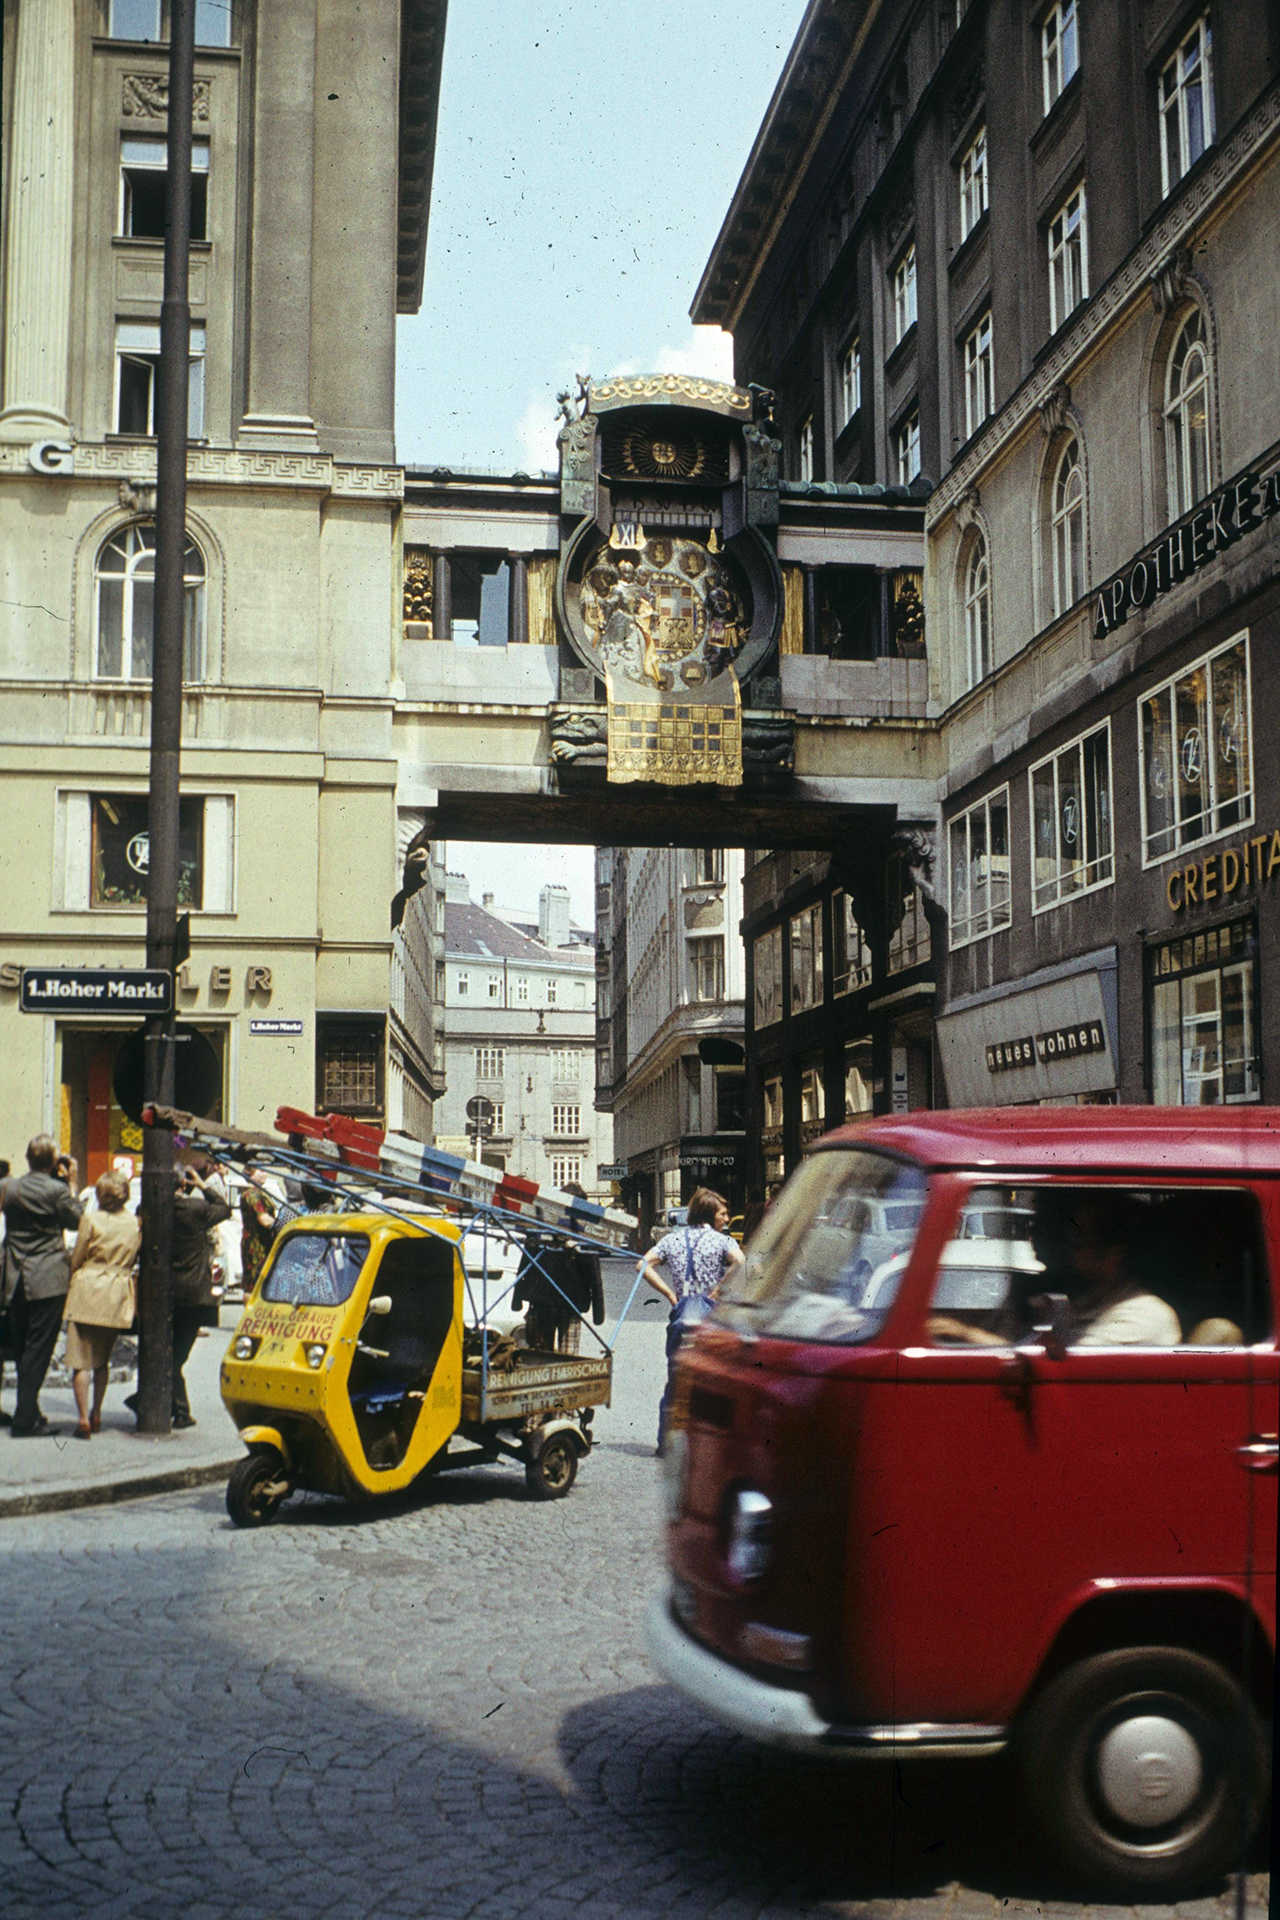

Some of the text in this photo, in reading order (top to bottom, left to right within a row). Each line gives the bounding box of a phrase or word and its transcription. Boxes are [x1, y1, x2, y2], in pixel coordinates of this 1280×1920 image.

[1095, 477, 1248, 636] APOTHEKE
[1166, 829, 1280, 912] CREDITA
[107, 980, 165, 999] Markt
[987, 1028, 1100, 1066] neues wohnen
[602, 1168, 625, 1176] HOTEL
[241, 1318, 333, 1340] REINIGUNG
[489, 1368, 550, 1387] REINIGUNG
